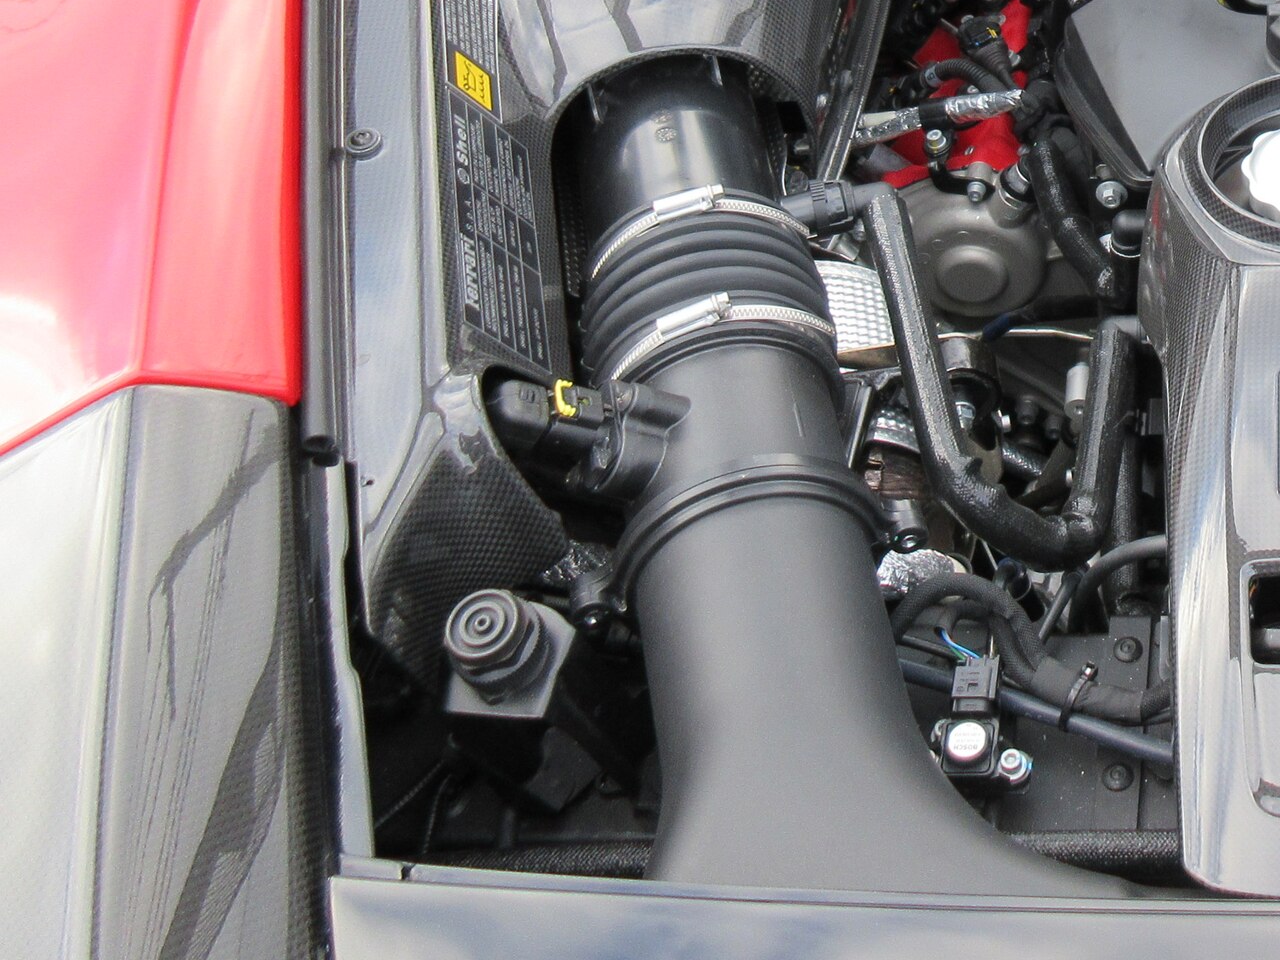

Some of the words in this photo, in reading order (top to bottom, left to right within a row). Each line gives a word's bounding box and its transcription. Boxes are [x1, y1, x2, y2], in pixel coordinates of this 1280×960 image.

[454, 113, 469, 167] Shell
[460, 232, 481, 311] Ferrari
[953, 743, 979, 751] BOSCH
